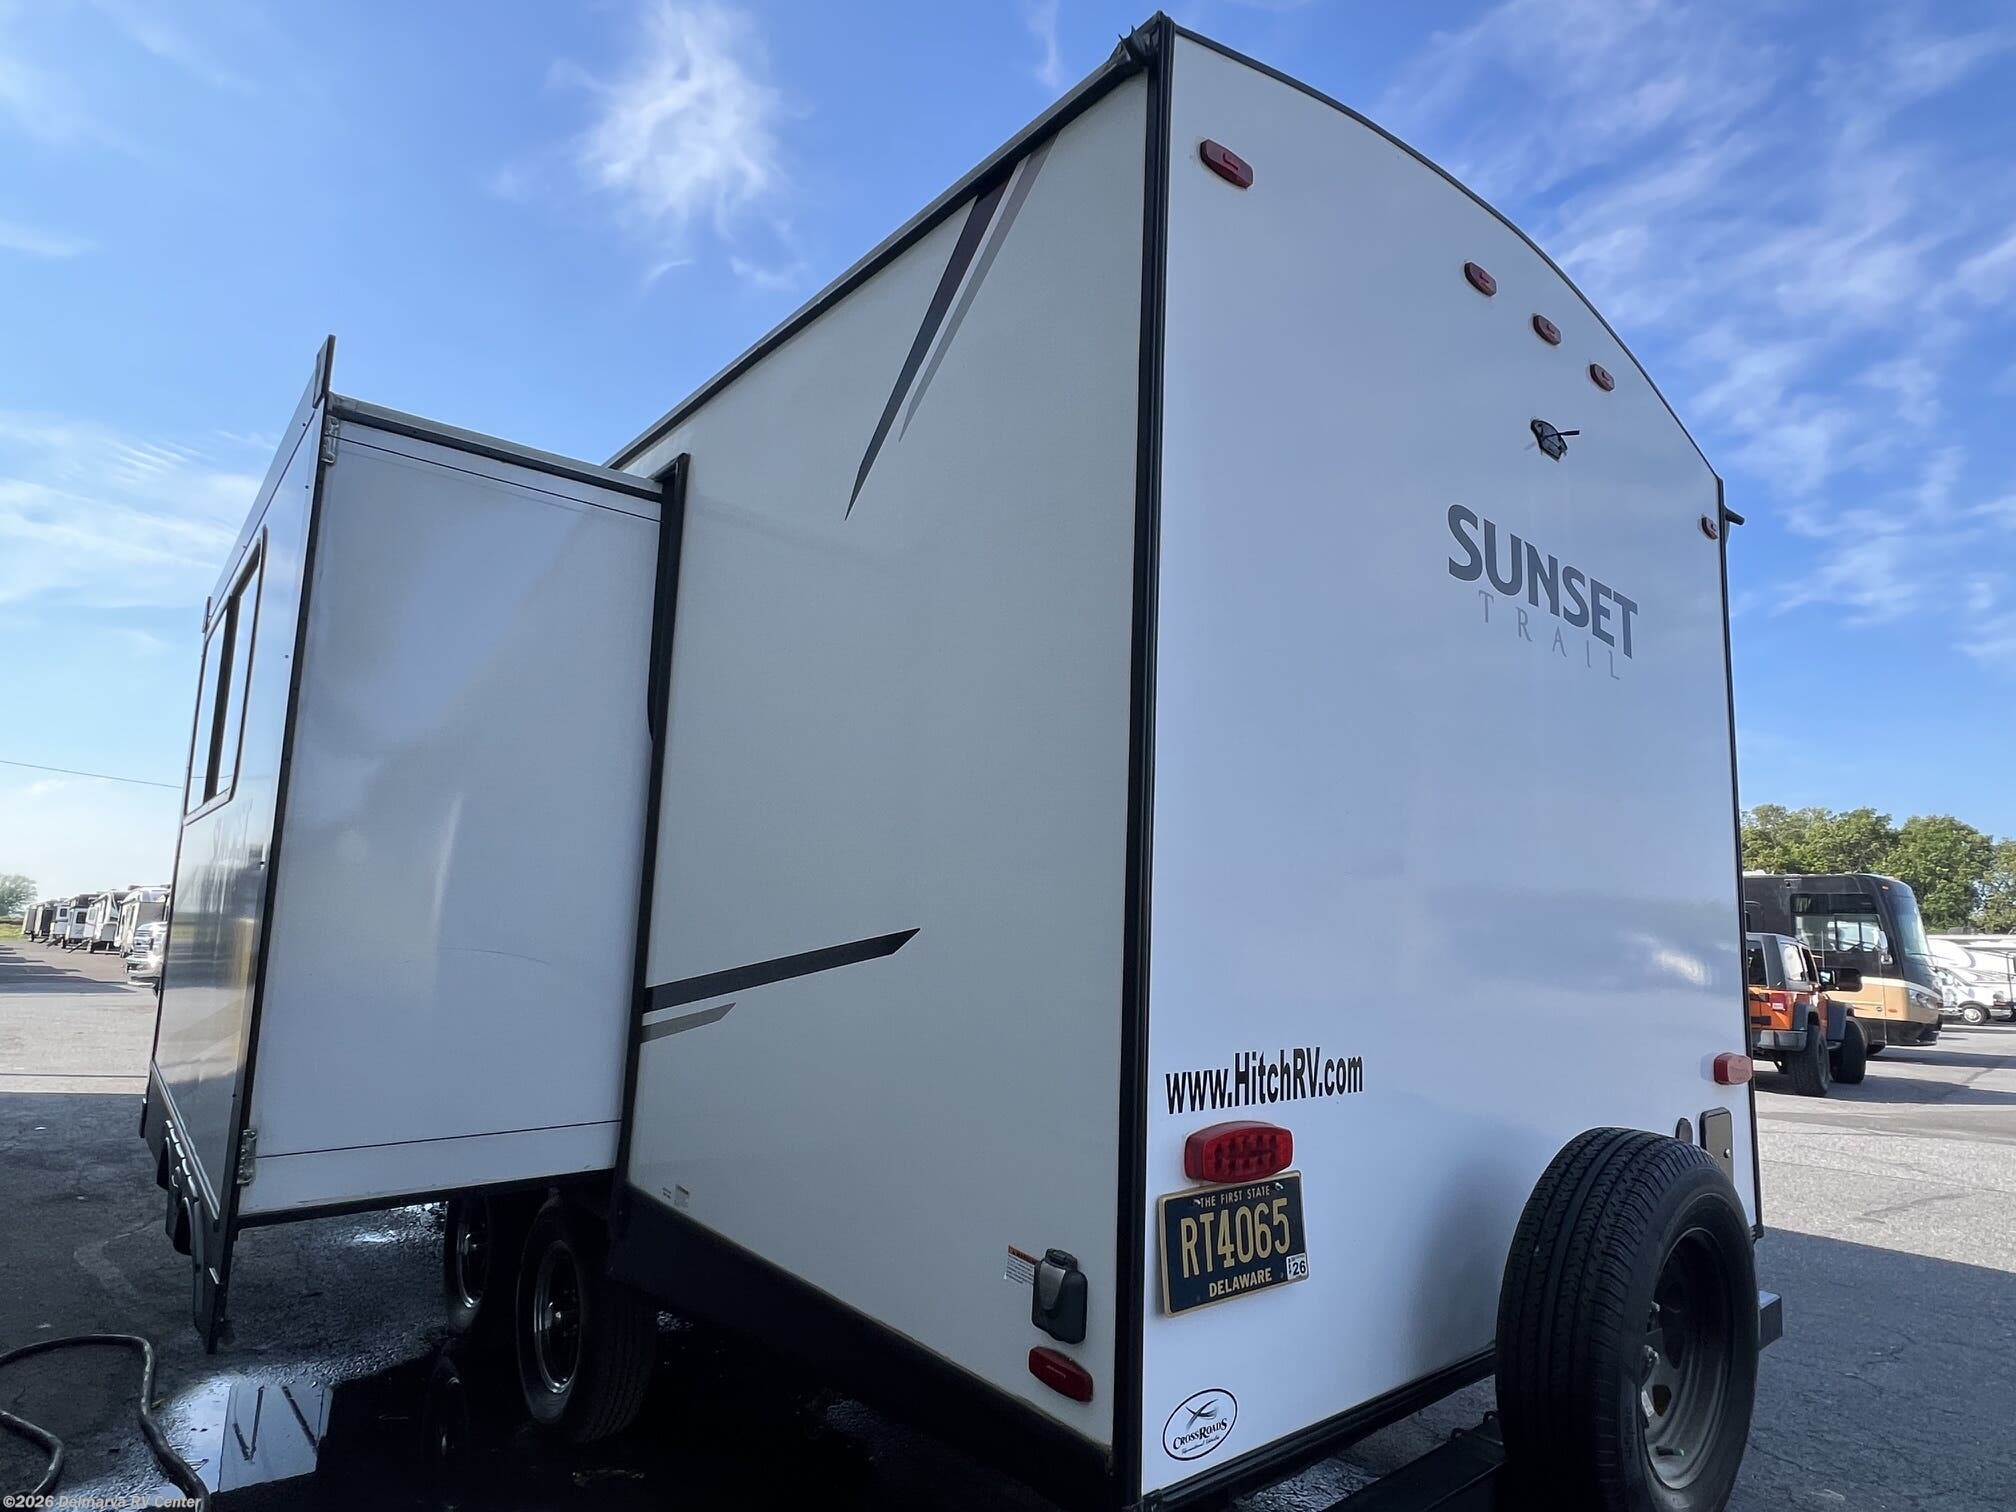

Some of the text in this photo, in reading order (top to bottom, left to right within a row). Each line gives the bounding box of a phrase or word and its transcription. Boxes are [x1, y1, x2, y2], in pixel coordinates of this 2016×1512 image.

[1447, 503, 1639, 660] SUNSET
[1478, 589, 1620, 680] TRAIL
[1165, 1046, 1363, 1115] www.HitchRV.com
[1200, 1185, 1270, 1208] THE FIRST STATE
[1180, 1197, 1291, 1279] RT4065
[1292, 1260, 1306, 1276] 26
[1208, 1267, 1272, 1298] DELAWARE
